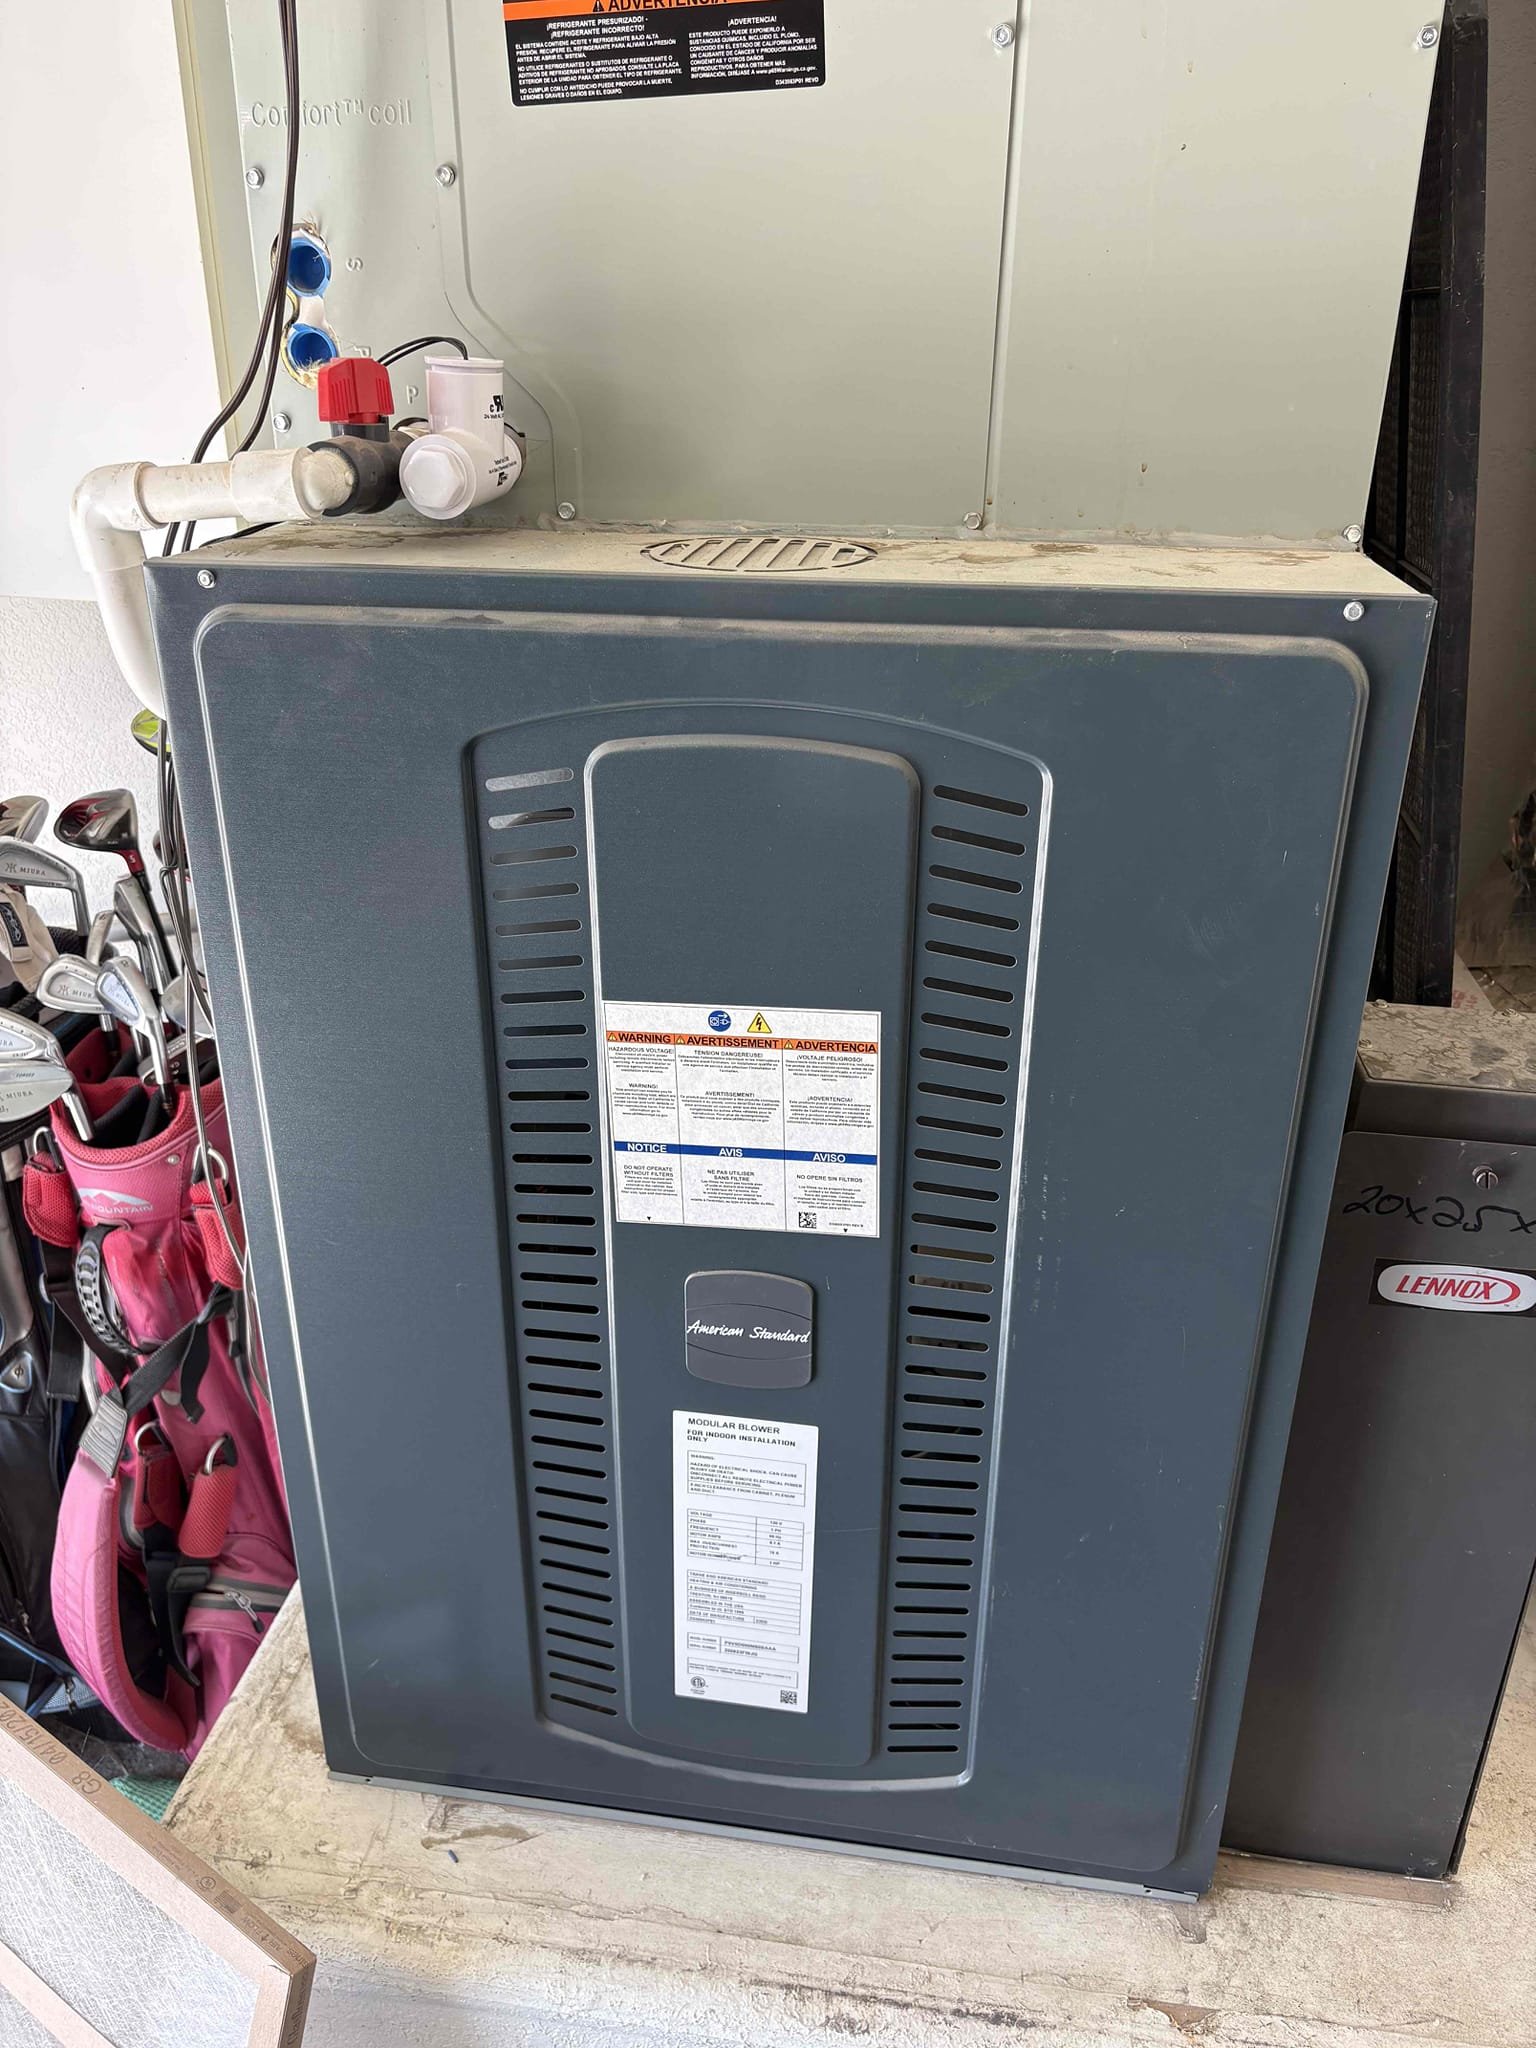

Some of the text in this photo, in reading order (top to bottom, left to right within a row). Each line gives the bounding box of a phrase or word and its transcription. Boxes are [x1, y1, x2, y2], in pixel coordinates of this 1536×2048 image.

[546, 16, 644, 31] ¡REFRIGERANTE PRESURIZADO!
[727, 16, 777, 27] ¡ADVERTENCIA!
[550, 25, 646, 39] ¡REFRIGERANTE INCORRECTO!
[702, 30, 730, 38] PRODUCTO
[749, 26, 780, 34] EXPONERLO
[592, 36, 631, 44] REFRIGERANTE
[761, 39, 792, 47] CALIFORNIA
[574, 44, 610, 52] REFRIGERANTE
[760, 46, 786, 54] PRODUCIR
[544, 61, 585, 70] REFRIGERANTES
[591, 59, 621, 67] SUSTITUTOS
[630, 56, 667, 64] REFRIGERANTE
[548, 68, 586, 77] REFRIGERANTE
[627, 63, 654, 71] CONSULTE
[518, 78, 543, 86] EXTERIOR
[569, 83, 597, 91] ANTEDICHO
[615, 80, 643, 88] PROVOCAR
[544, 92, 565, 100] GRAVES
[368, 99, 412, 126] coil
[20, 867, 46, 876] MIURA
[618, 1033, 671, 1044] WARNING
[686, 1037, 778, 1049] AVERTISSEMENT
[796, 1041, 876, 1053] ADVERTENCIA
[627, 1143, 667, 1153] NOTICE
[718, 1148, 743, 1158] AVIS
[812, 1153, 846, 1163] AVISO
[1396, 1275, 1498, 1300] LENNOX
[686, 1320, 811, 1344] American Standard
[688, 1418, 780, 1434] MODULAR BLOWER
[706, 1431, 736, 1440] INDOOR
[739, 1435, 796, 1447] INSTALLATION
[72, 1771, 103, 1794] G8
